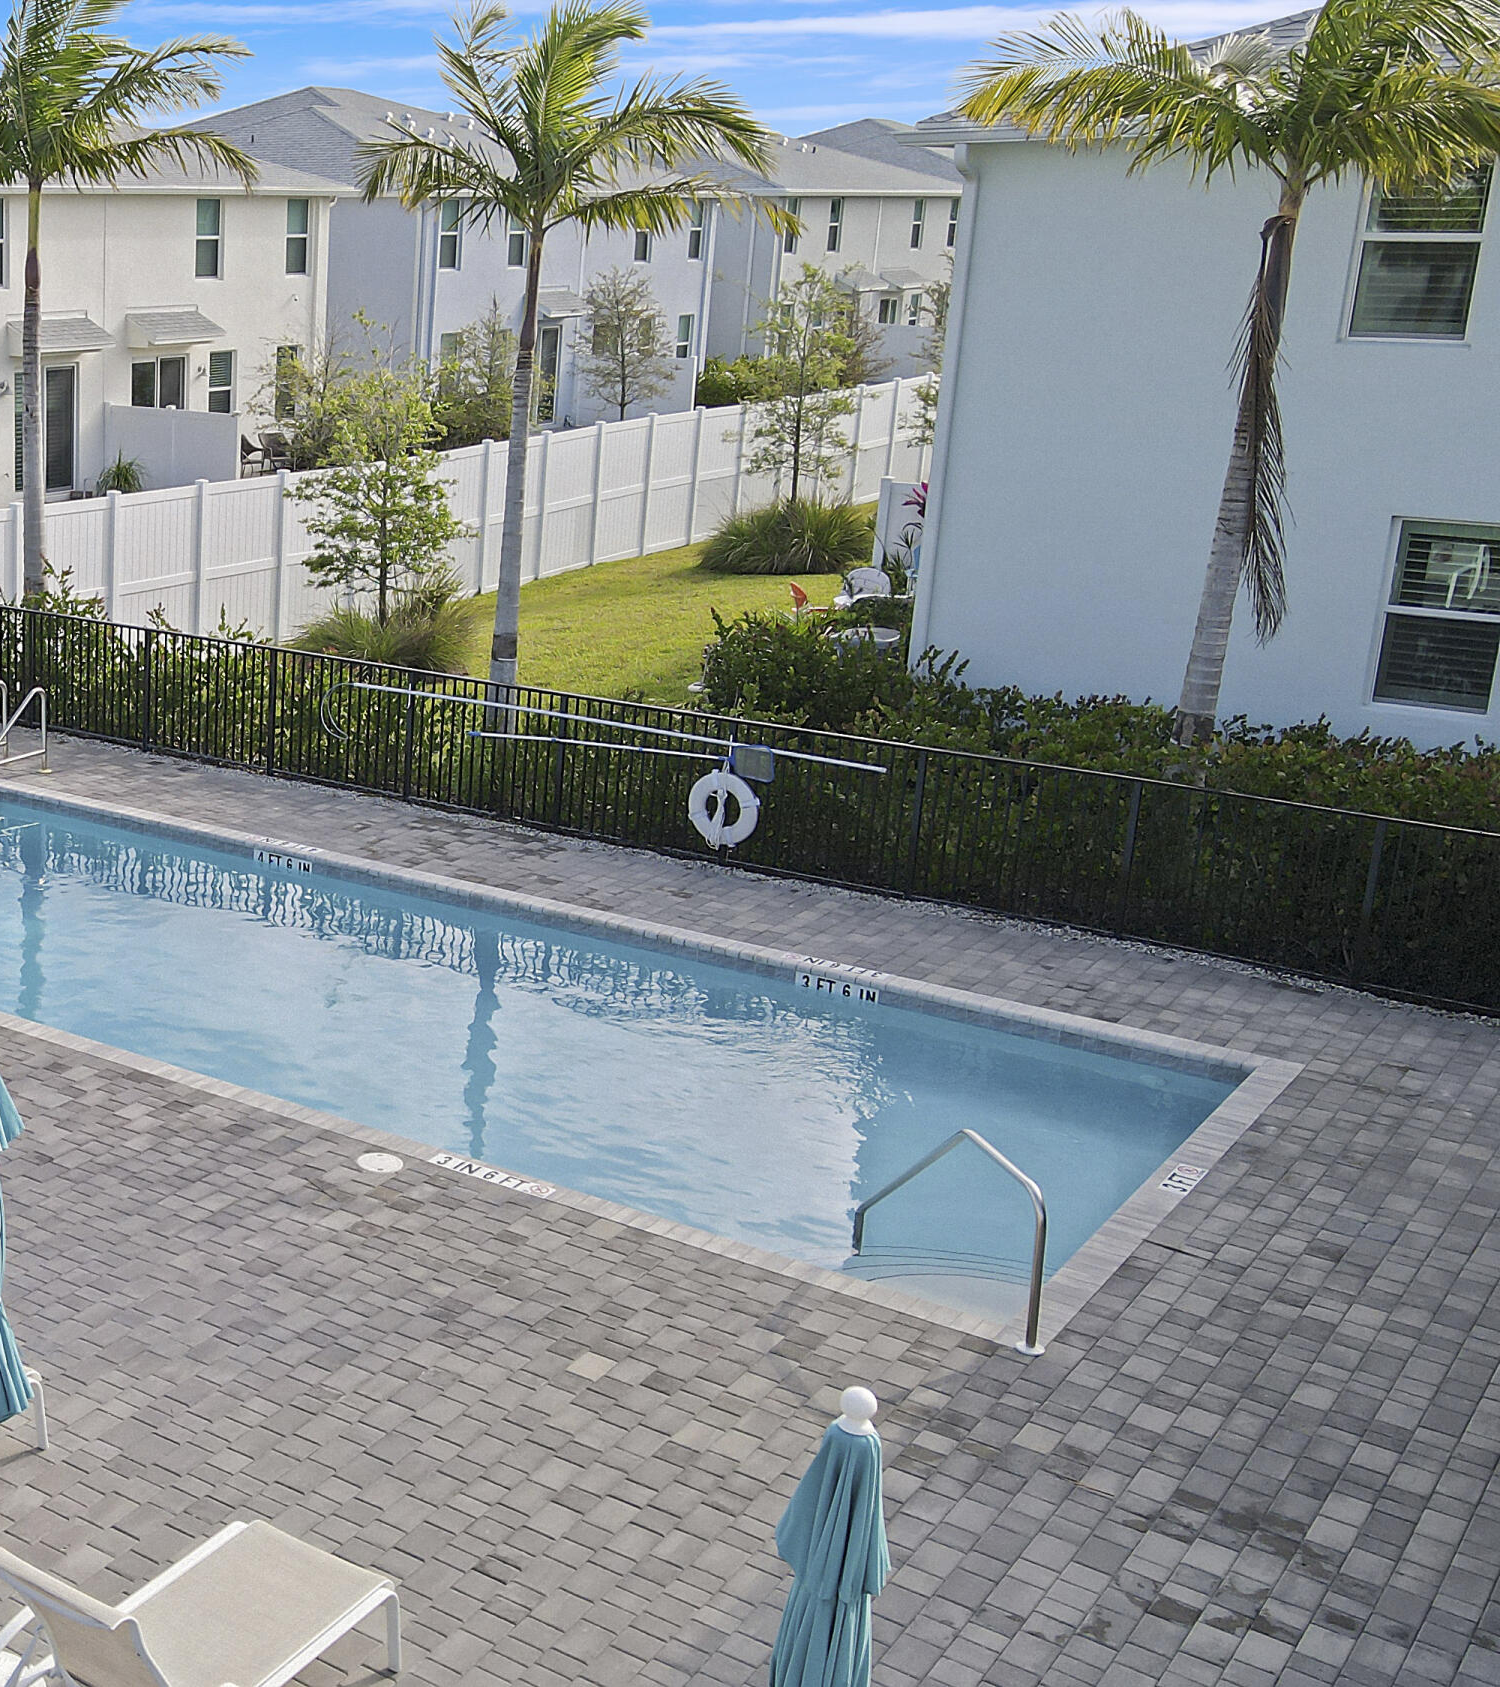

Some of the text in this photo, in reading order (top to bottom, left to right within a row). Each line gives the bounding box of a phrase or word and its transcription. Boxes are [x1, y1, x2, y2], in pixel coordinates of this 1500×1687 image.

[268, 853, 282, 867] FT
[286, 858, 293, 869] 6
[299, 862, 310, 872] IN
[801, 975, 876, 1003] 3 FT 6 IN
[436, 1156, 530, 1189] 3 IN 6 FT
[1162, 1172, 1198, 1192] 3 FT
